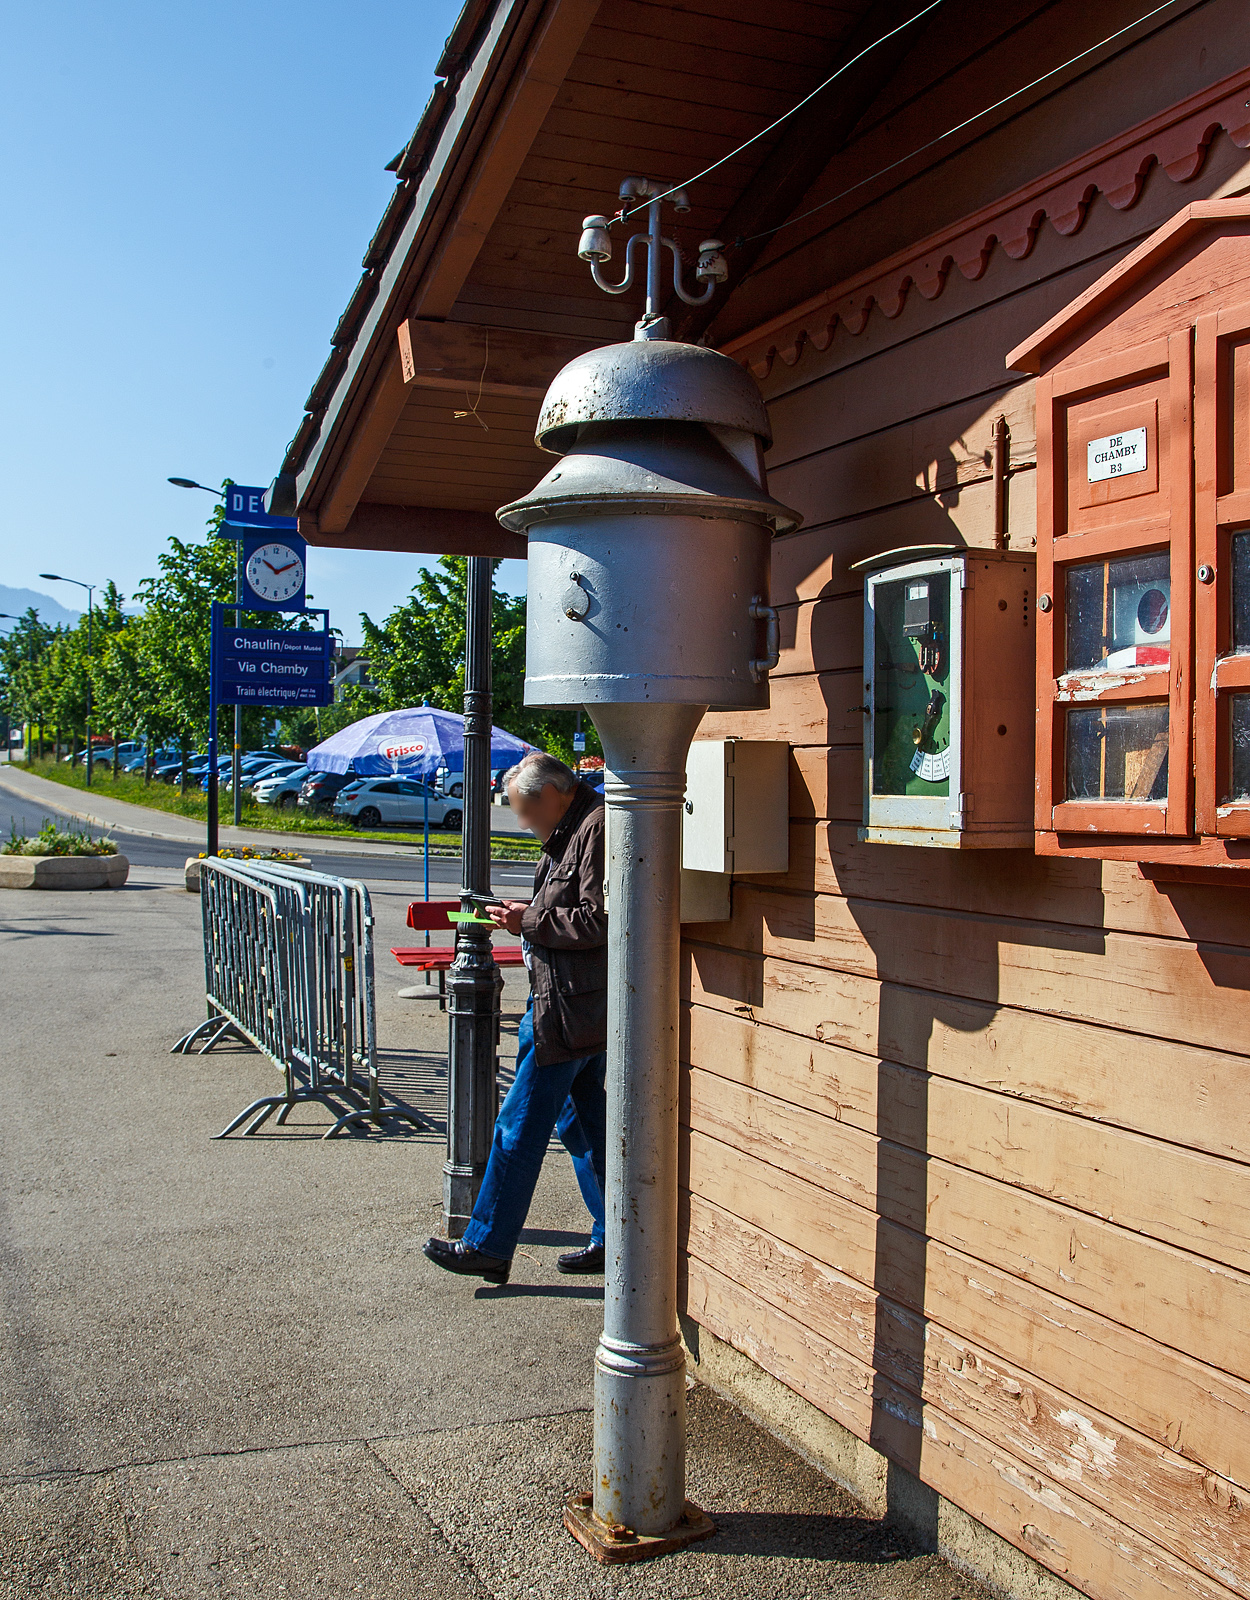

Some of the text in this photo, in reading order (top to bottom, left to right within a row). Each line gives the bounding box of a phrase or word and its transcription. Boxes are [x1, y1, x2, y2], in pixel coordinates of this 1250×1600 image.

[1109, 436, 1123, 448] DE
[1094, 443, 1138, 464] CHAMBY
[1110, 462, 1122, 474] B3
[233, 494, 259, 513] DE
[273, 547, 280, 555] 12
[237, 661, 308, 677] Via Chamby
[236, 685, 256, 696] Train
[574, 733, 580, 741] P
[386, 745, 424, 759] Frisco
